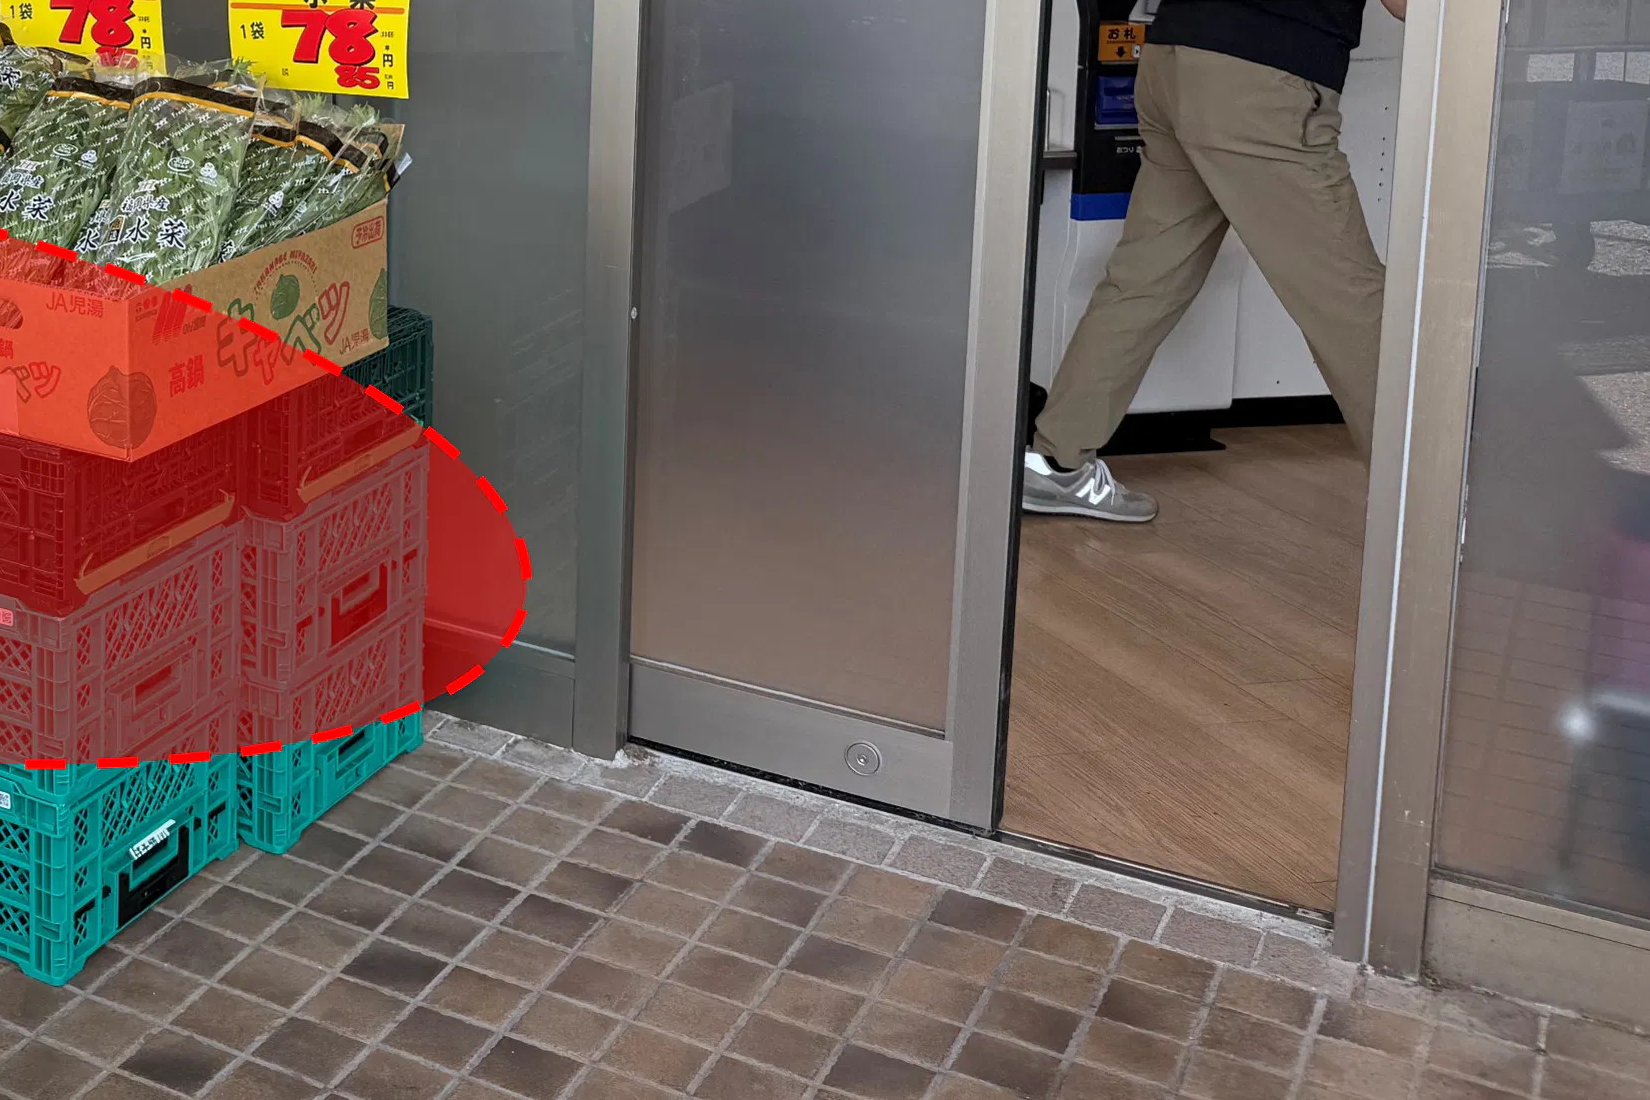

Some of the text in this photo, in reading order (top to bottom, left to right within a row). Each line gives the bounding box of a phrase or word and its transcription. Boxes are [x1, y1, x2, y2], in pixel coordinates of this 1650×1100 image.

[10, 3, 32, 20] 1袋
[140, 36, 152, 49] 円
[240, 21, 264, 39] 1袋
[281, 9, 379, 65] 78
[1107, 28, 1136, 41] お札
[383, 54, 394, 68] 円
[335, 64, 380, 89] 85
[0, 190, 54, 220] 水菜
[126, 217, 188, 249] 水菜
[46, 292, 104, 318] JA児湯
[340, 328, 370, 354] JA児湯
[168, 354, 204, 398] 高鍋
